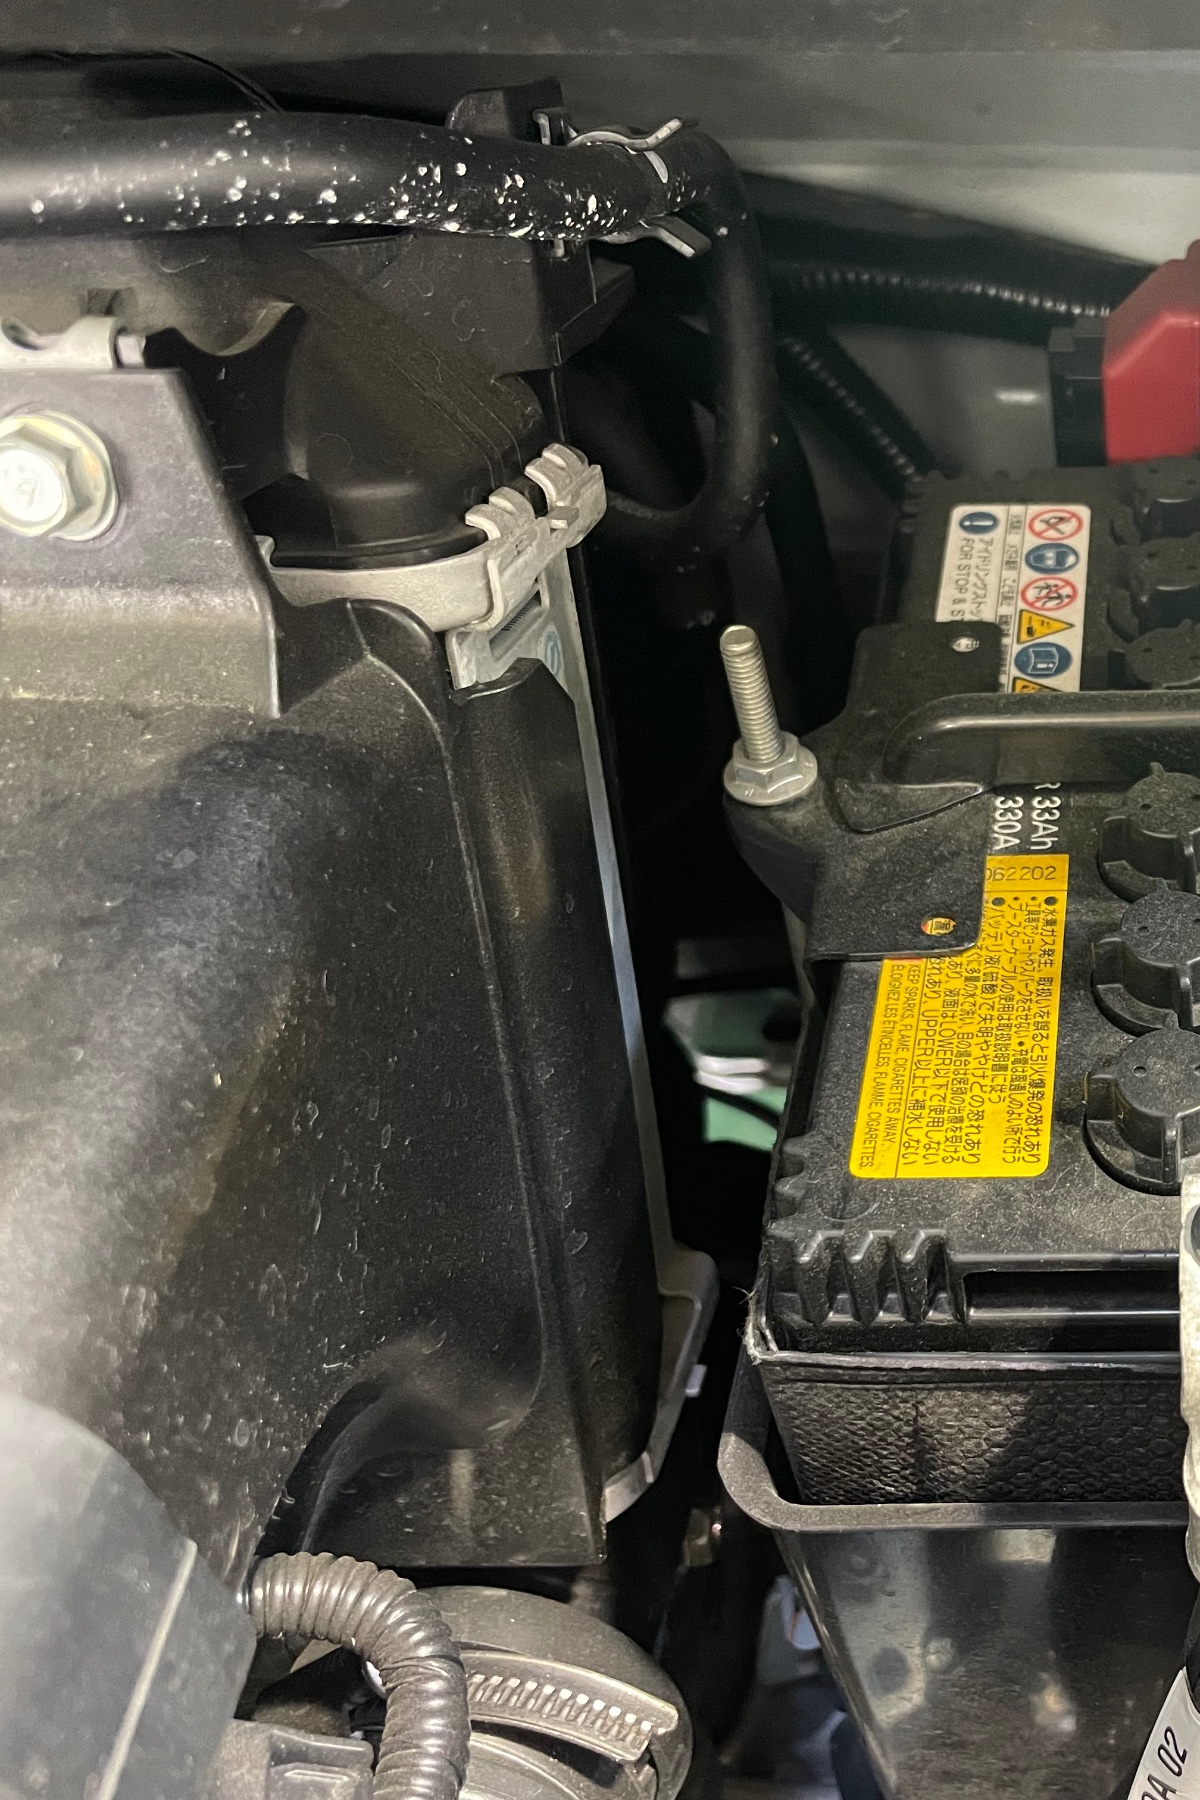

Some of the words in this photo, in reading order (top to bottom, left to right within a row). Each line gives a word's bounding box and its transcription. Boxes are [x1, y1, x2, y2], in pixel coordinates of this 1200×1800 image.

[958, 537, 974, 560] FOR
[953, 564, 970, 593] STOP
[950, 609, 964, 620] S
[992, 796, 1024, 850] 330A
[1030, 796, 1062, 850] 33Ah
[885, 964, 906, 1001] ÉLOIGNEZ
[906, 964, 921, 983] KEEP
[883, 1003, 898, 1017] LES
[899, 986, 918, 1021] SPARKS,
[873, 1020, 900, 1068] ÉTINCELLES,
[894, 1023, 912, 1054] FLAME,
[920, 957, 965, 1164] あり、液面はLOWER以下で使用しない
[866, 1071, 887, 1109] FLAMME,
[886, 1057, 907, 1113] CIGARETTES
[858, 1112, 881, 1169] CIGARETTES.
[1157, 1725, 1188, 1777] 02
